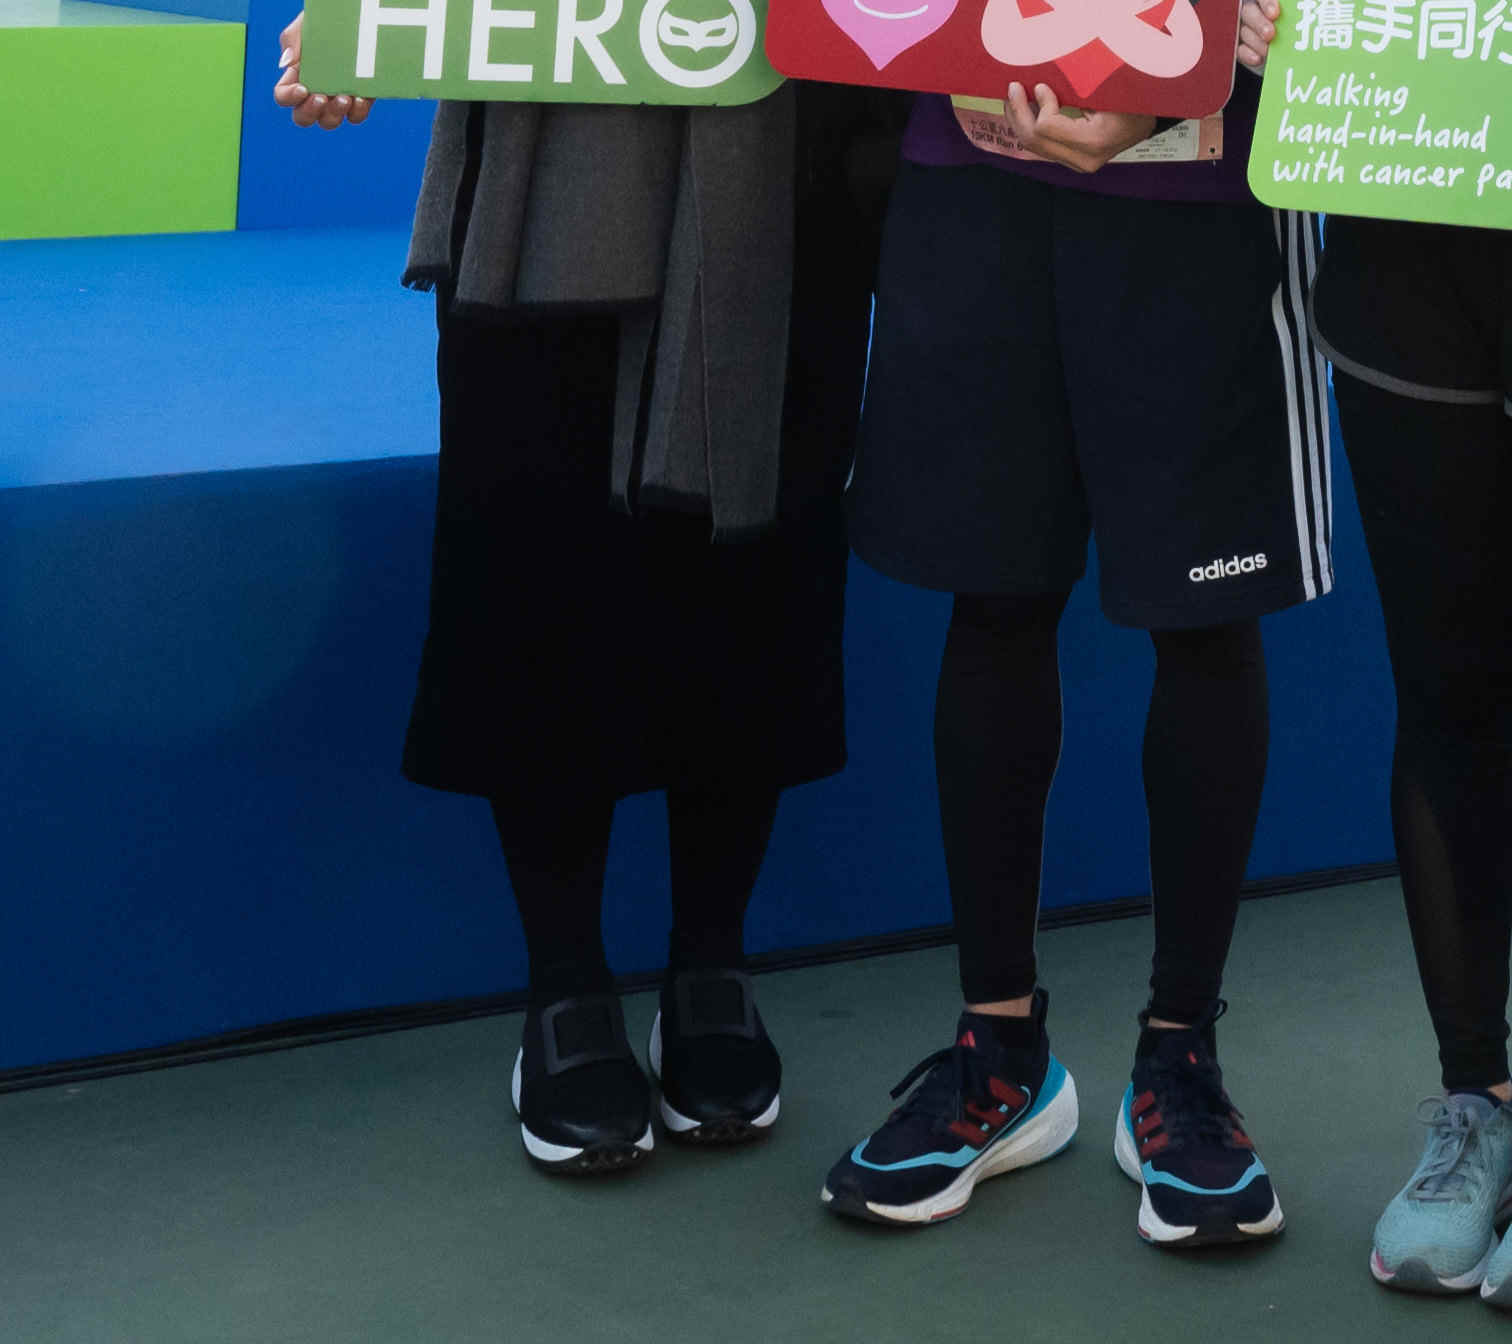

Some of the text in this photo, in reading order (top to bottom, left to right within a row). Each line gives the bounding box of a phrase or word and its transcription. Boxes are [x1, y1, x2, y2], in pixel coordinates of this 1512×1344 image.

[1284, 68, 1410, 116] Walking
[1276, 108, 1491, 153] hand-in-hand
[1272, 145, 1346, 184] with
[1359, 157, 1465, 189] cancer
[1188, 550, 1268, 583] adidas
